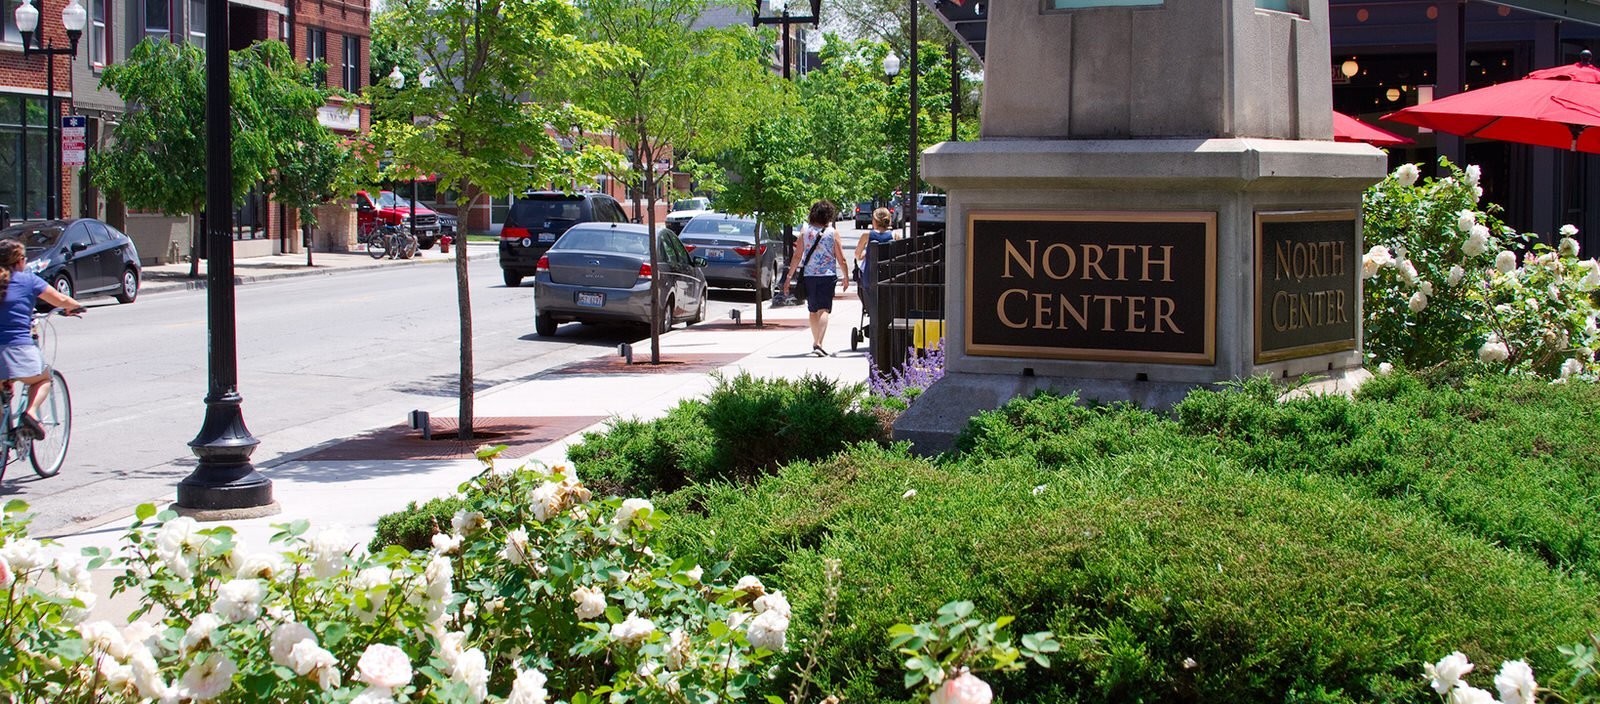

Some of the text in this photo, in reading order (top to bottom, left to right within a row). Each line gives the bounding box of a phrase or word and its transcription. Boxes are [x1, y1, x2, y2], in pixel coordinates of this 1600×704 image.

[1000, 238, 1175, 282] NORTH
[1274, 240, 1345, 281] NORTH
[996, 288, 1185, 335] CENTER
[1271, 289, 1348, 332] CENTER
